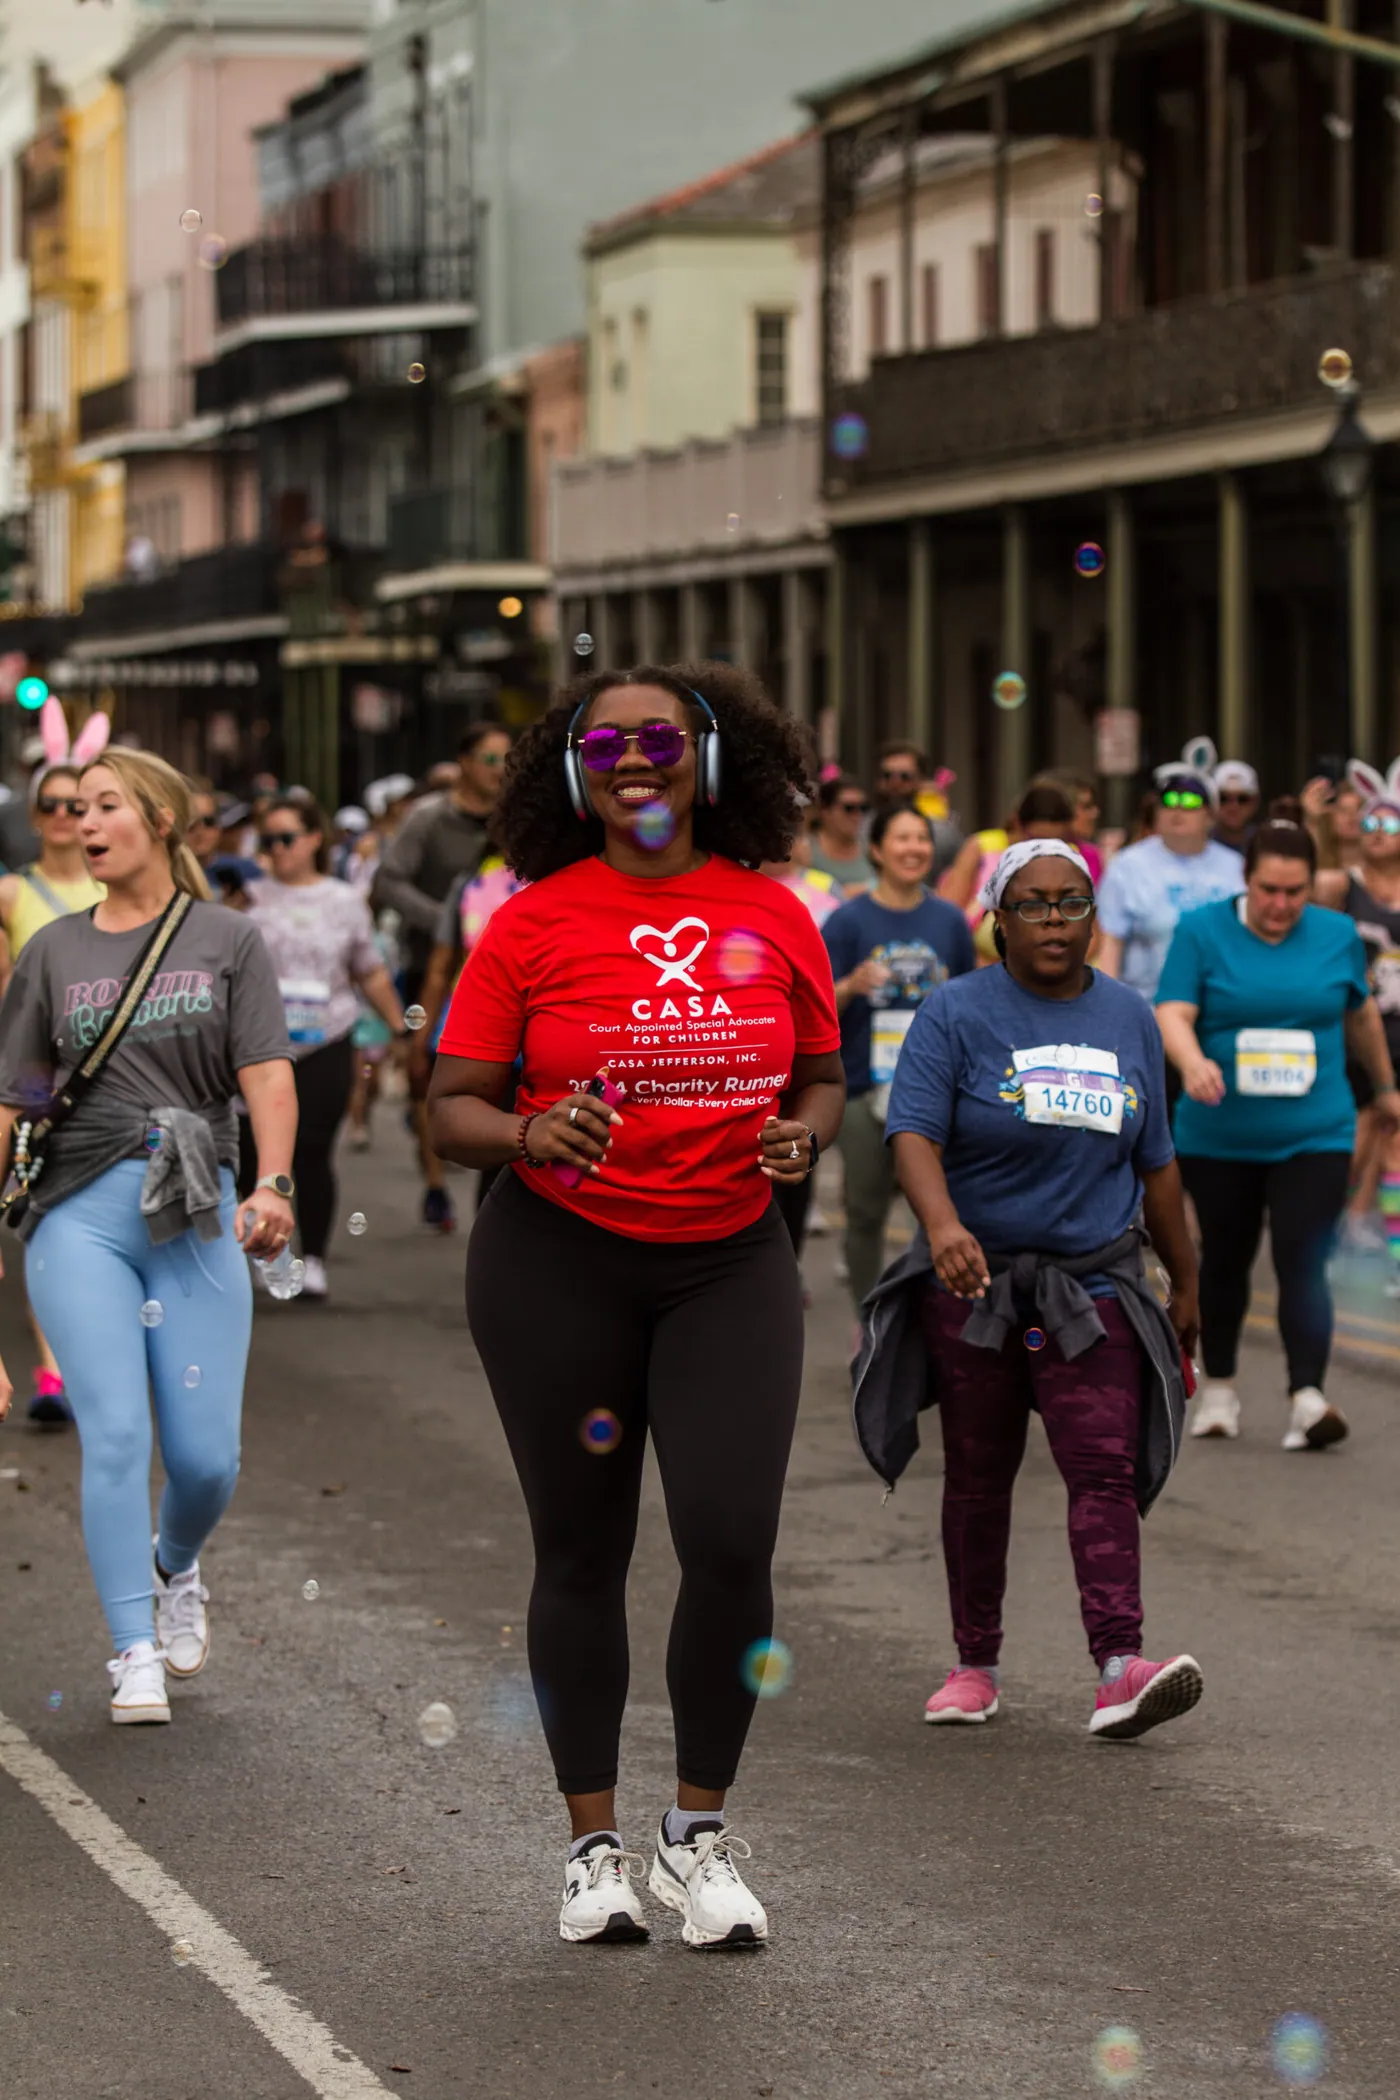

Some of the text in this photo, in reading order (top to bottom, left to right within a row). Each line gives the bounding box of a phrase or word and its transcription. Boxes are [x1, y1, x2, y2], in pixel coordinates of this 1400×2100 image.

[632, 994, 732, 1020] CASA
[71, 985, 213, 1050] Baoons
[589, 1016, 776, 1034] Court Appointed Special Advocates
[633, 1031, 737, 1045] FOR CHILDREN
[608, 1053, 762, 1068] CASA JEFFERSON, INC.
[568, 1073, 788, 1096] 24 Charity Runner
[1066, 1072, 1081, 1088] G
[663, 1096, 728, 1109] Dollar-Every
[731, 1096, 755, 1107] Child
[1042, 1088, 1113, 1117] 14760
